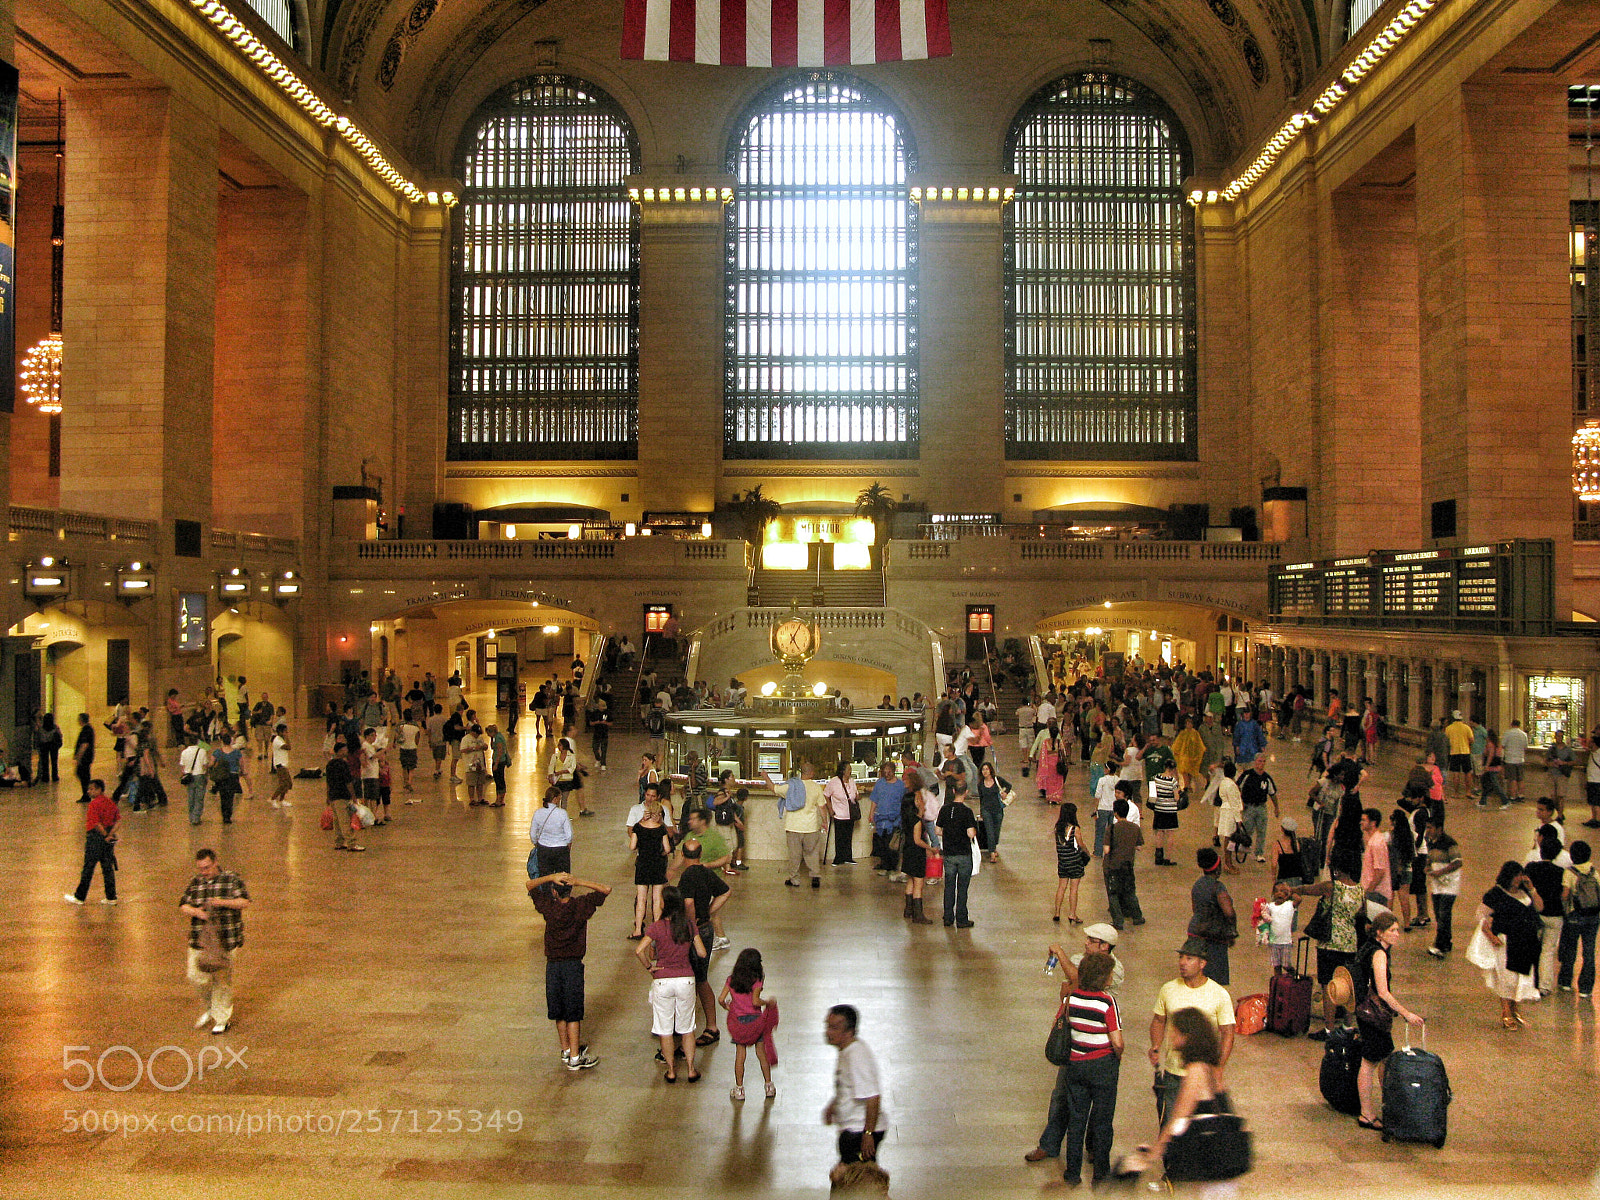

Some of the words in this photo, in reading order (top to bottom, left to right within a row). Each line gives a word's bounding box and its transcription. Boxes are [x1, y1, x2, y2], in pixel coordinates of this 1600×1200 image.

[500, 590, 550, 602] LEXINGTON
[1120, 591, 1137, 599] AVE
[1167, 591, 1202, 601] SUBWAY
[485, 618, 509, 627] STREET
[511, 616, 541, 624] PASSAGE
[548, 617, 577, 625] SUBWAY
[1049, 619, 1076, 628] STREET
[1077, 617, 1109, 625] PASSAGE
[1112, 617, 1143, 626] SUBWAY
[778, 700, 818, 708] Information
